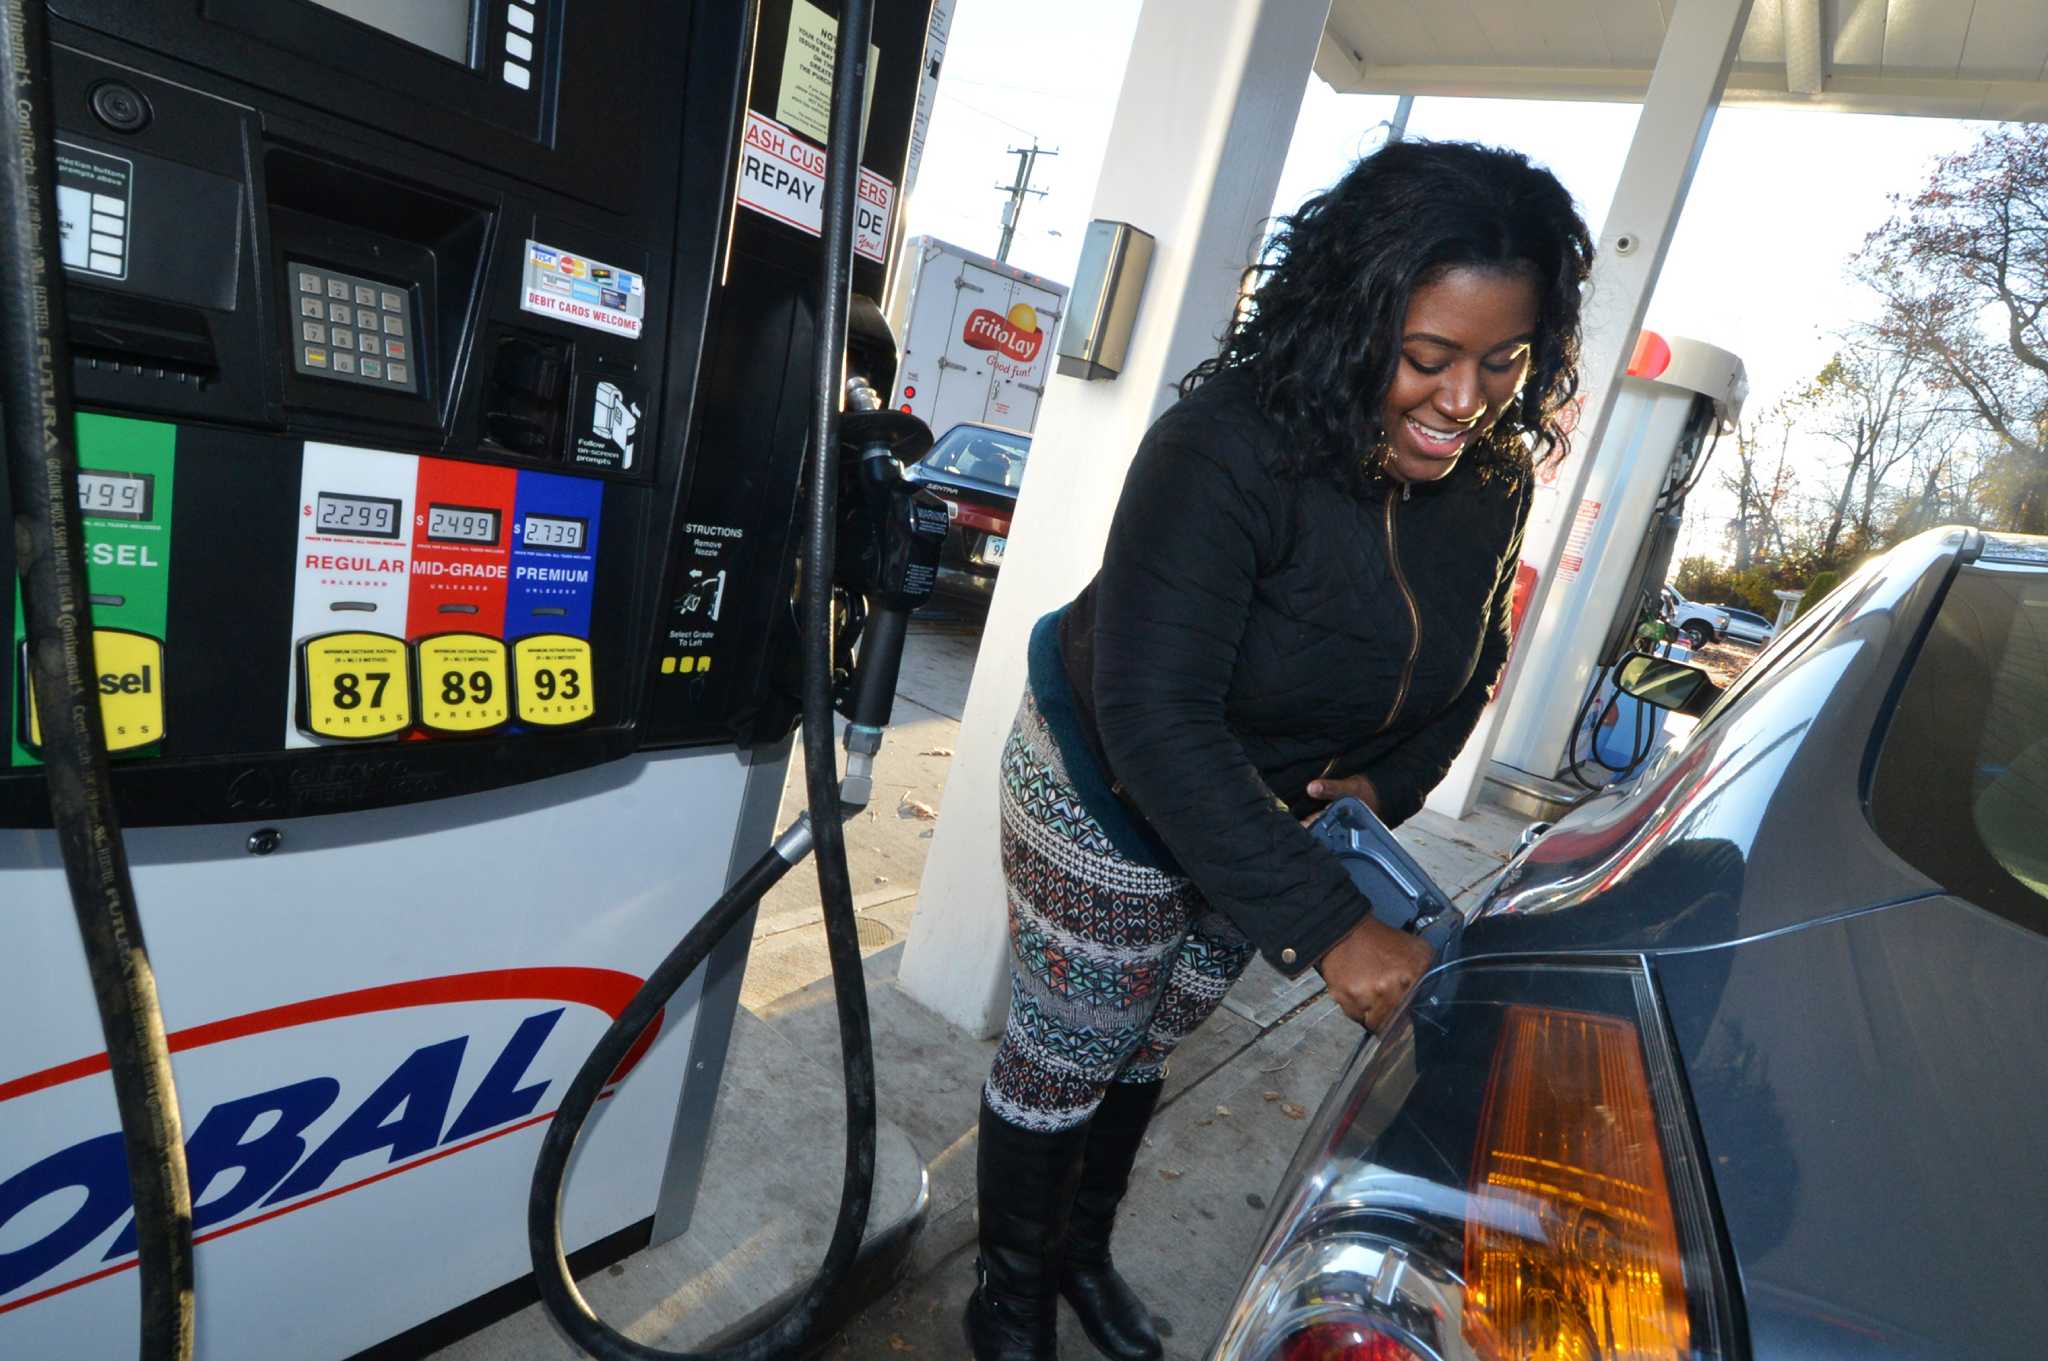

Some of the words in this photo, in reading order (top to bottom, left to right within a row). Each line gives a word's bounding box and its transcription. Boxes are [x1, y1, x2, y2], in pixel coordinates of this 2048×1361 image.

[528, 292, 556, 309] DEBIT
[559, 301, 591, 319] CARDS
[592, 310, 638, 331] WELCOME
[322, 503, 389, 528] 2.299
[431, 513, 489, 537] 2.499
[526, 523, 577, 545] 2.739
[83, 542, 159, 567] SEL
[305, 554, 405, 574] REGULAR
[412, 560, 508, 579] MID-GRADE
[515, 566, 590, 583] PREMIUM
[333, 672, 391, 710] 87
[441, 670, 493, 706] 89
[534, 667, 581, 701] 93
[325, 713, 404, 725] PRESS
[434, 709, 502, 719] PRESS
[529, 705, 589, 715] PRESS
